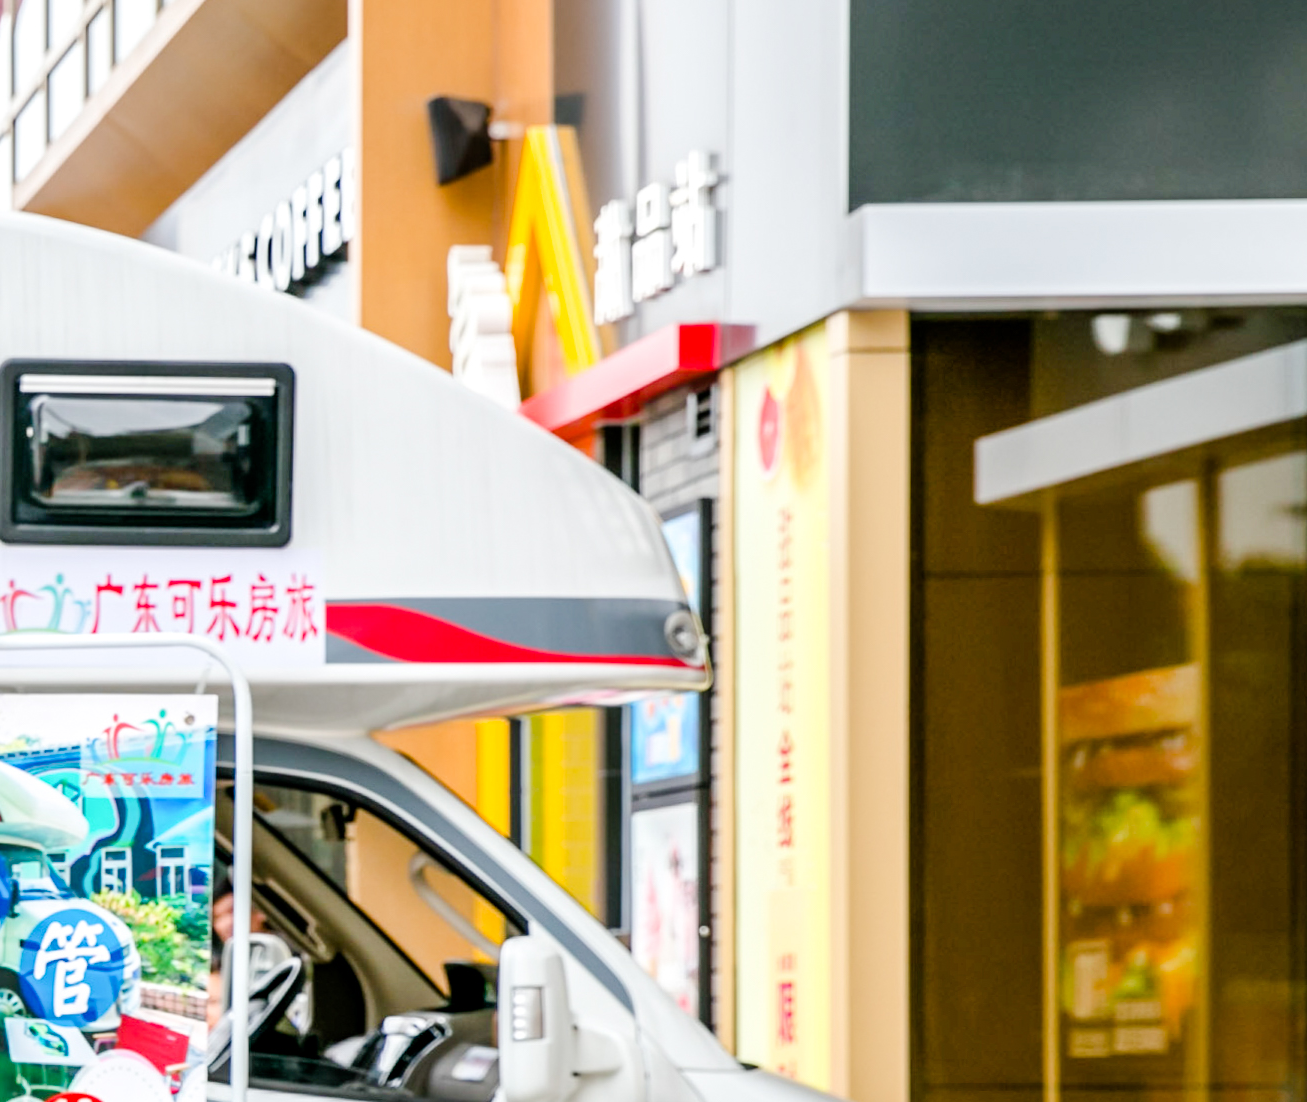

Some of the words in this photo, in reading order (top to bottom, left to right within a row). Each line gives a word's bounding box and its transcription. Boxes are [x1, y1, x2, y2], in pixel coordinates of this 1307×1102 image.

[92, 572, 318, 643] 广东可乐房旅
